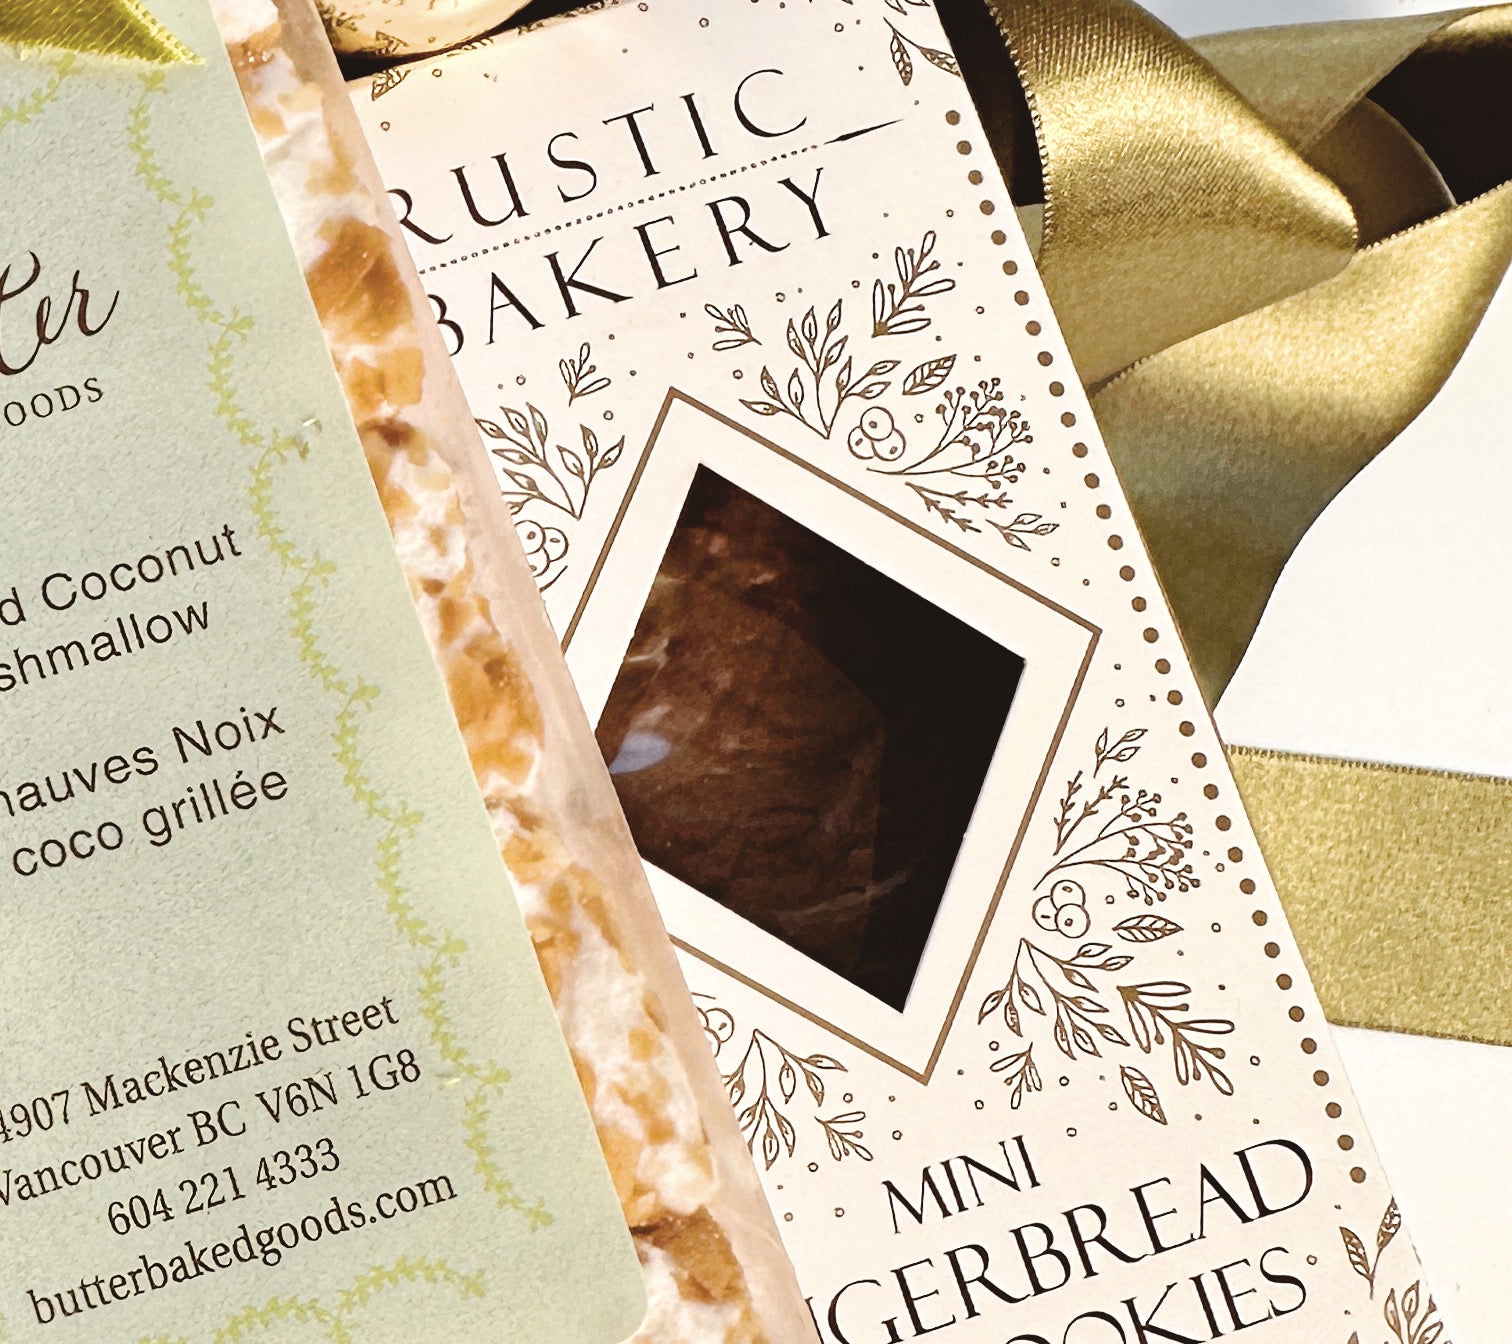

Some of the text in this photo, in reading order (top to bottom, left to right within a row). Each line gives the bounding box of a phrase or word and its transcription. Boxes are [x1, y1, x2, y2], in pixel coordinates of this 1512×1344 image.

[386, 68, 808, 245] RUSTIC
[427, 167, 833, 357] BAKERY
[39, 523, 243, 611] Coconut
[172, 703, 286, 764] Noix
[12, 817, 124, 875] coco
[142, 768, 289, 846] grillée
[80, 1032, 283, 1119] Mackenzie
[287, 995, 400, 1053] Street
[188, 1101, 247, 1152] BC
[255, 1070, 338, 1125] V6N
[347, 1048, 421, 1101] 1G8
[107, 1137, 339, 1235] 604 221 4333
[881, 1135, 1041, 1234] MINI
[27, 1168, 458, 1325] butterbakedgoods.com
